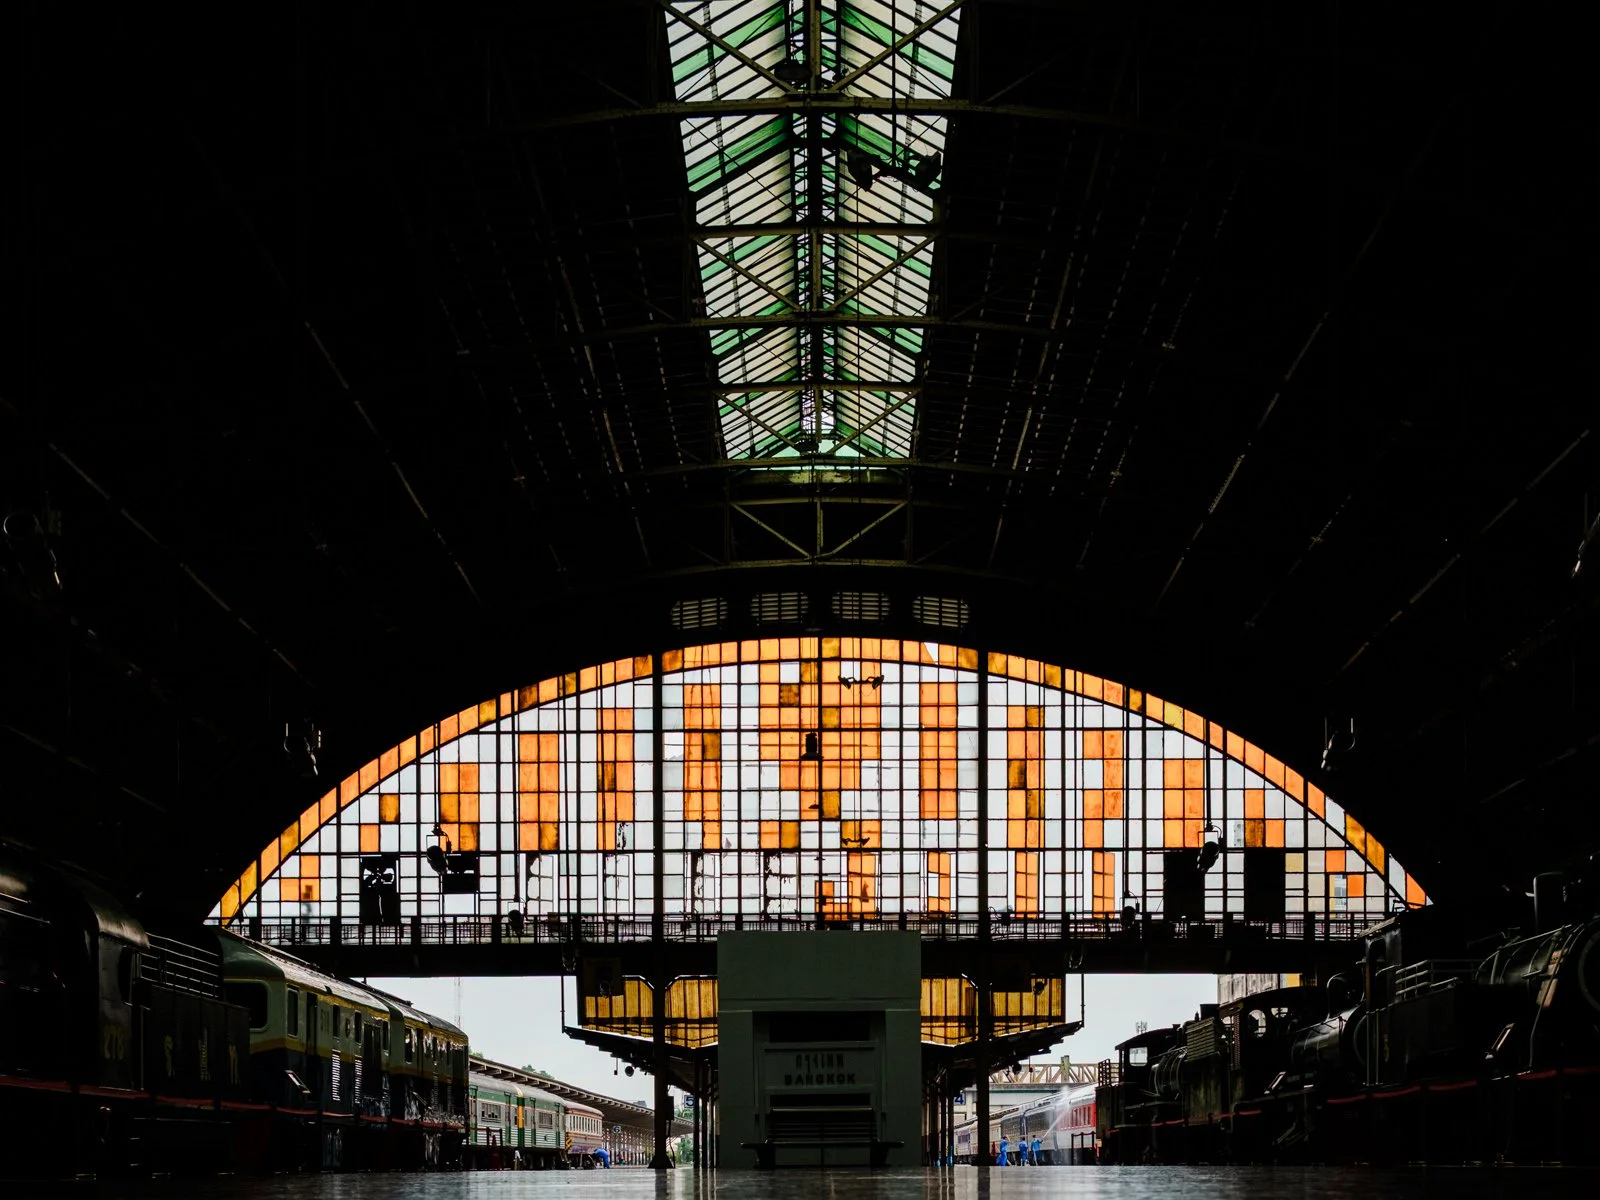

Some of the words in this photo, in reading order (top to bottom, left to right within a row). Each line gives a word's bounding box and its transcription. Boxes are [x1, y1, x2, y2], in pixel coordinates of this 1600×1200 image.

[785, 1073, 855, 1086] BANGKOK
[686, 1096, 695, 1107] 5
[954, 1092, 965, 1105] 4
